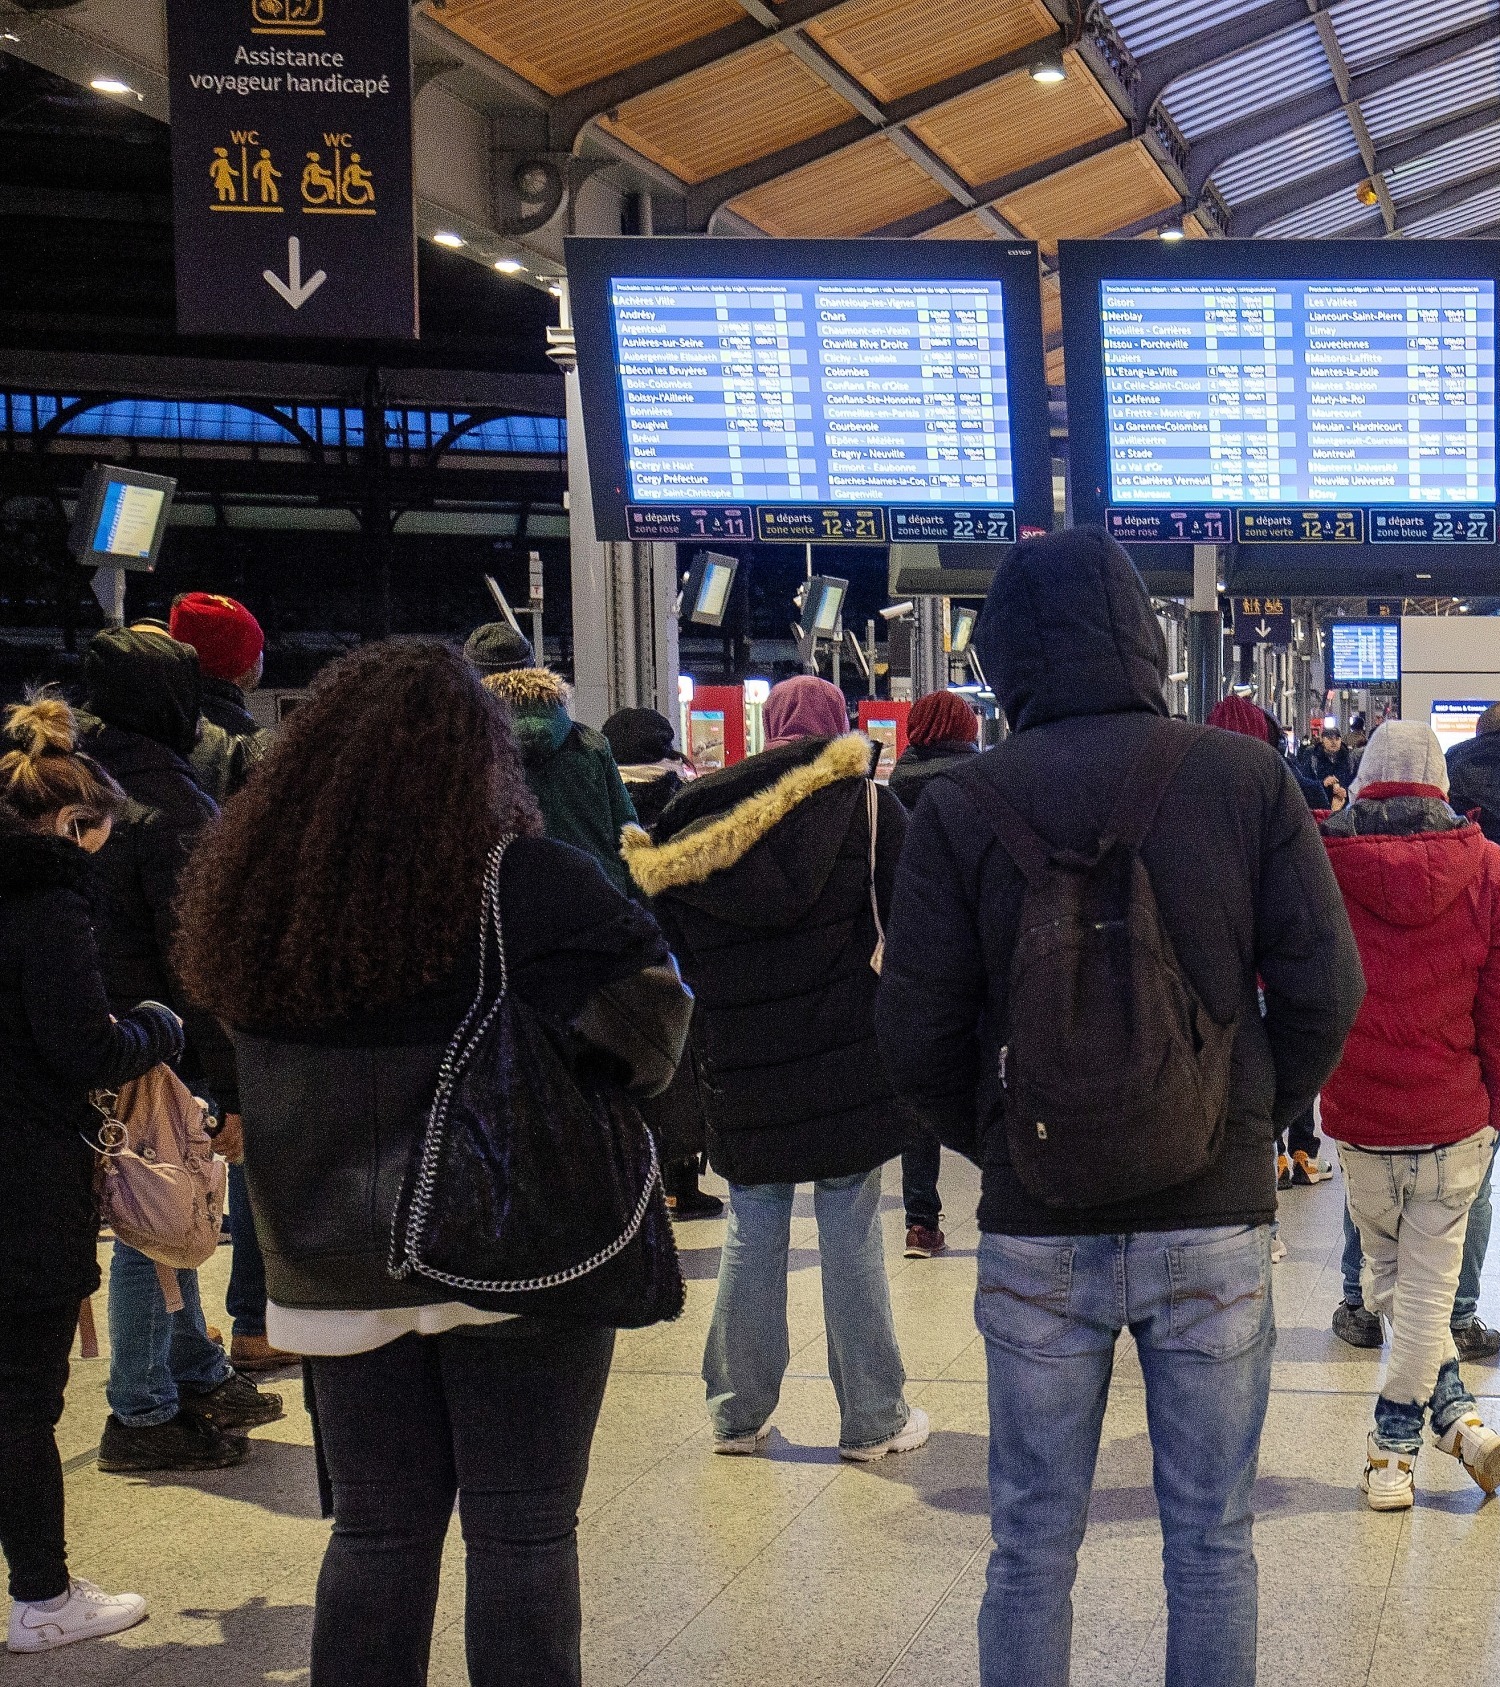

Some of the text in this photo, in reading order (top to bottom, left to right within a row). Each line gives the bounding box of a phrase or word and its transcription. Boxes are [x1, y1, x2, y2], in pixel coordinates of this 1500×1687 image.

[234, 45, 344, 67] Assistance
[189, 73, 390, 98] voyageur handicapé
[230, 130, 260, 145] WC
[323, 132, 353, 147] WC
[1107, 297, 1136, 307] Gisors
[619, 309, 656, 321] Andrésy
[820, 311, 847, 321] Chars
[1108, 311, 1143, 323] Herblay
[622, 337, 705, 348] Asnières-sur-Seine
[822, 338, 909, 350] Chaville Rive Droite
[1140, 338, 1189, 349] Porcheville
[1309, 338, 1370, 349] Louveciennes
[625, 364, 708, 377] Bécon les Bruyères
[825, 366, 870, 377] Colombes
[1310, 366, 1380, 377] Mantes-la-Jolie
[1112, 394, 1160, 405] La Défense
[630, 420, 670, 432] Bougival
[829, 421, 880, 432] Courbevoie
[633, 447, 657, 457] Bueil
[1115, 448, 1153, 459] Le Stade
[636, 474, 709, 486] Cergy Préfecture
[645, 512, 681, 523] départs
[776, 513, 812, 524] départs
[908, 514, 944, 525] départs
[1124, 516, 1160, 526] départs
[1256, 515, 1292, 526] départs
[1388, 516, 1424, 527] départs
[635, 526, 680, 534] zone rose
[695, 518, 744, 534] 1 11
[766, 526, 815, 534] zone verte
[822, 519, 877, 535] 12 21
[897, 526, 948, 536] zone bleue
[953, 520, 1008, 537] 22 27
[1174, 521, 1223, 537] 1 11
[1302, 522, 1356, 538] 12 21
[1432, 522, 1488, 538] 22 27
[1113, 529, 1158, 537] zone rose
[1245, 529, 1294, 537] zone verte
[1377, 528, 1428, 537] zone bleue
